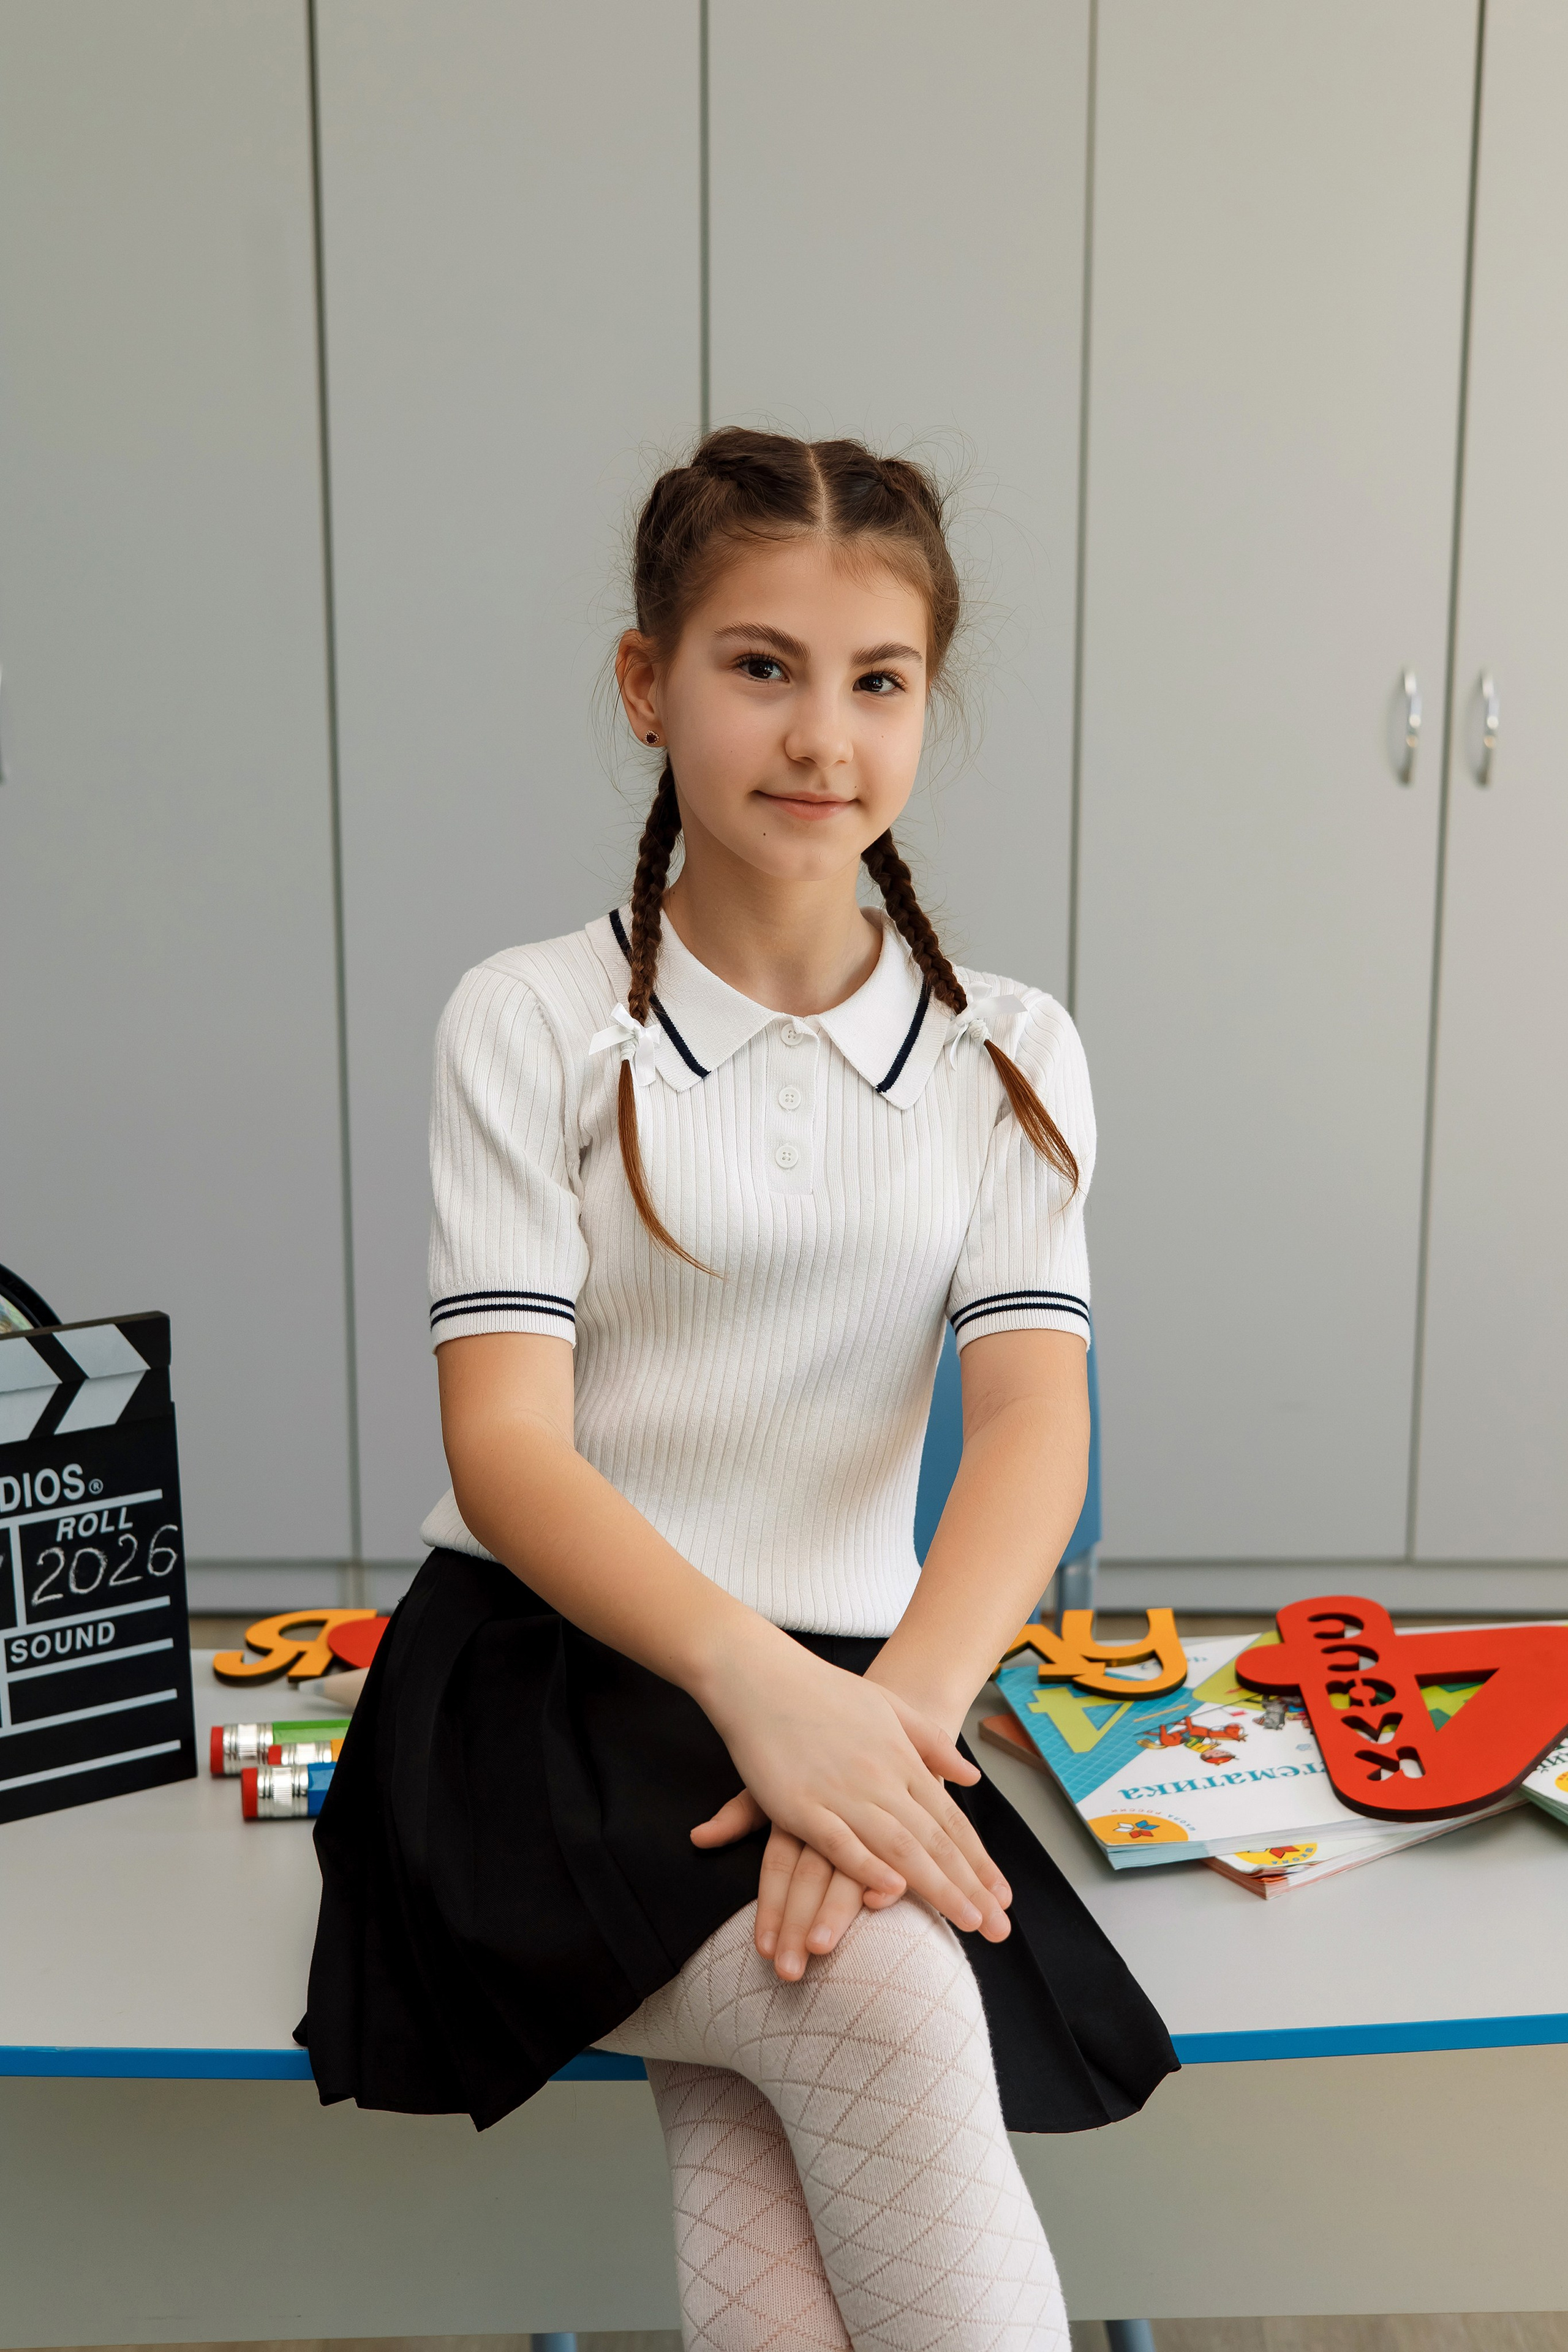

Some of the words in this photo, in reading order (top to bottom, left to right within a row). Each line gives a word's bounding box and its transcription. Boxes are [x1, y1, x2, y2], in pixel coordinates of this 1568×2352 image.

[56, 1507, 133, 1542] ROLL
[32, 1524, 178, 1606] 2026
[10, 1621, 115, 1664] SOUND
[1117, 1760, 1327, 1800] тематика
